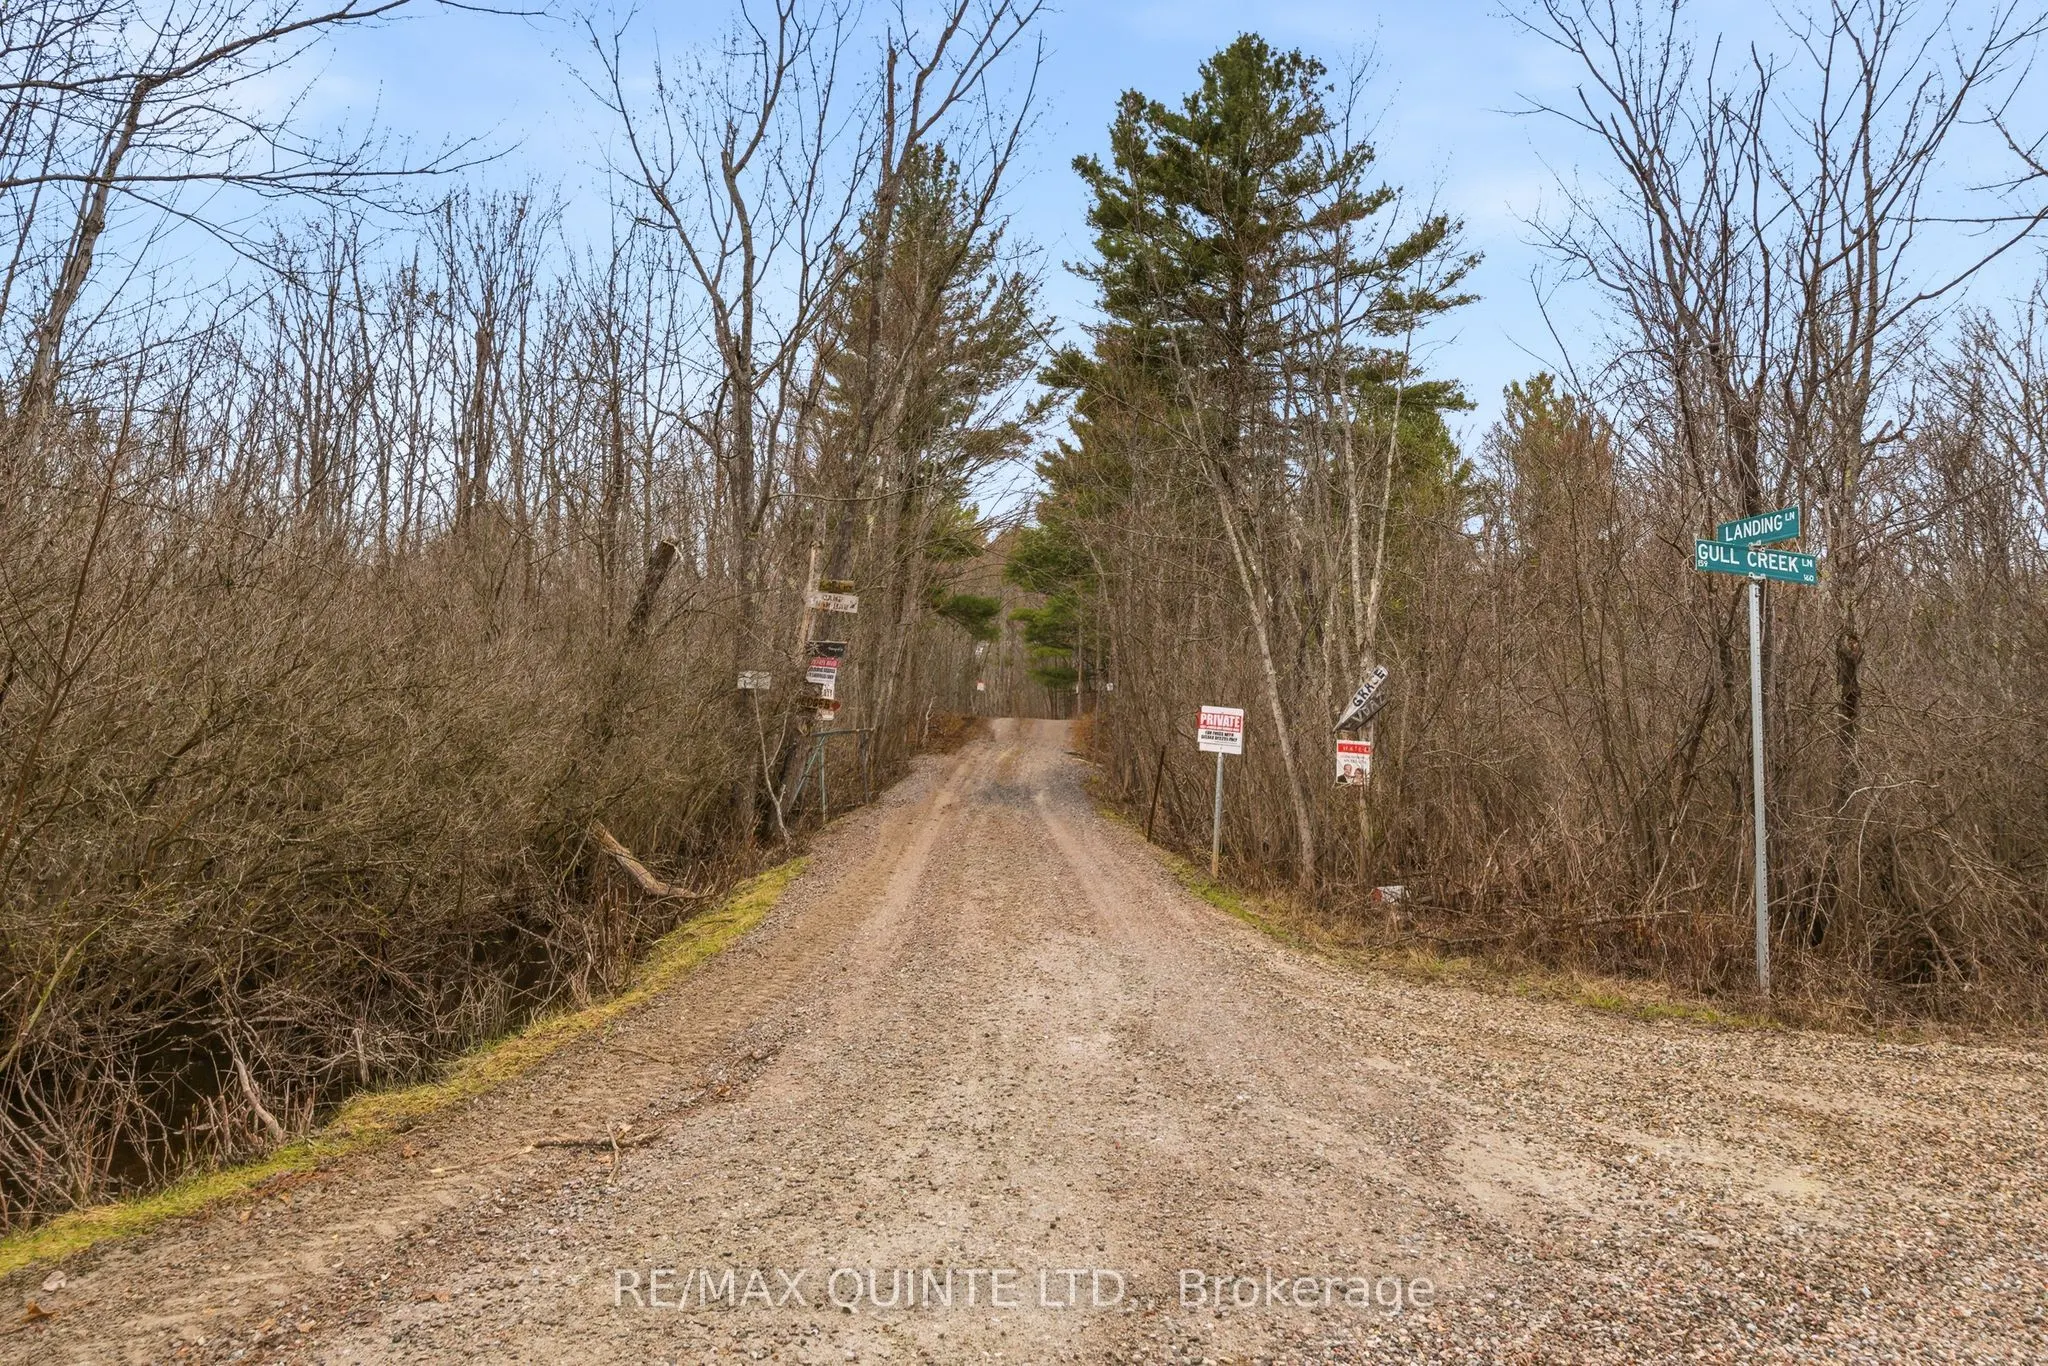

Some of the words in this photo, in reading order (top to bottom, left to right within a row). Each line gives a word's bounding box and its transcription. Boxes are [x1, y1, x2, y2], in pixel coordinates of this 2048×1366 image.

[1725, 514, 1783, 542] LANDING
[1784, 511, 1795, 522] LN
[1698, 543, 1740, 565] GULL
[1747, 551, 1799, 573] CREEK
[1801, 558, 1813, 568] LN
[1200, 713, 1240, 728] PRIVATE
